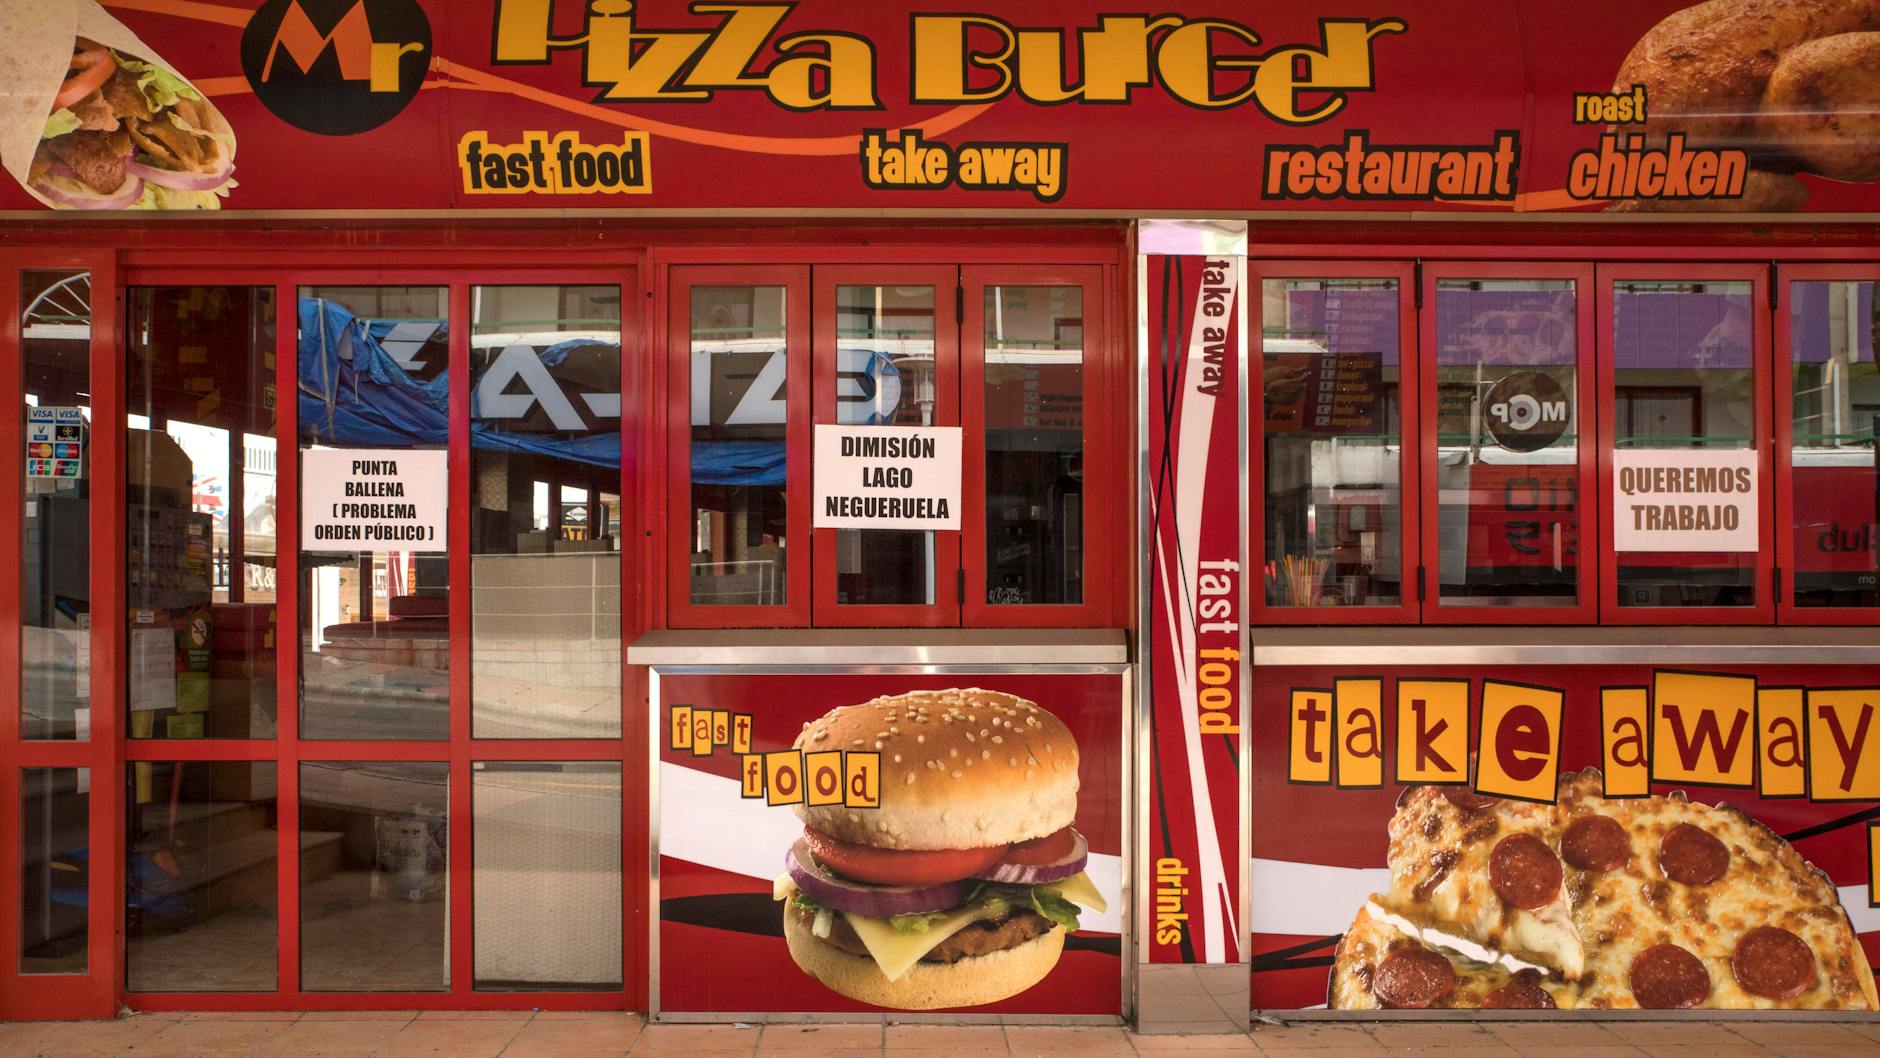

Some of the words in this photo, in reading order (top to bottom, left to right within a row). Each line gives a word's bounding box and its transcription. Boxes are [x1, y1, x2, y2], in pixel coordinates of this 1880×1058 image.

[262, 0, 426, 93] Mr
[1576, 88, 1646, 122] roast
[466, 138, 548, 189] fast
[556, 138, 645, 189] food
[865, 135, 949, 185] take
[959, 142, 1061, 196] away
[1267, 136, 1516, 195] restaurant
[1569, 134, 1748, 197] chicken
[1201, 259, 1232, 317] take
[1196, 326, 1226, 398] away
[32, 410, 53, 418] VISA
[59, 410, 80, 419] VISA
[841, 433, 935, 459] DIMISIÓN
[345, 481, 405, 497] BALLENA
[352, 460, 398, 476] PUNTA
[862, 466, 913, 489] LAGO
[1619, 466, 1752, 496] QUEREMOS
[826, 496, 950, 519] NEGUERUELA
[1630, 504, 1739, 531] TRABAJO
[314, 526, 361, 541] ORDEN
[364, 523, 425, 541] PÚBLICO
[1199, 558, 1240, 634] fast
[1199, 647, 1240, 736] food
[674, 711, 751, 748] fast
[1297, 698, 1552, 781] take
[1610, 703, 1877, 793] away
[745, 760, 878, 803] food
[1155, 856, 1190, 945] drinks
